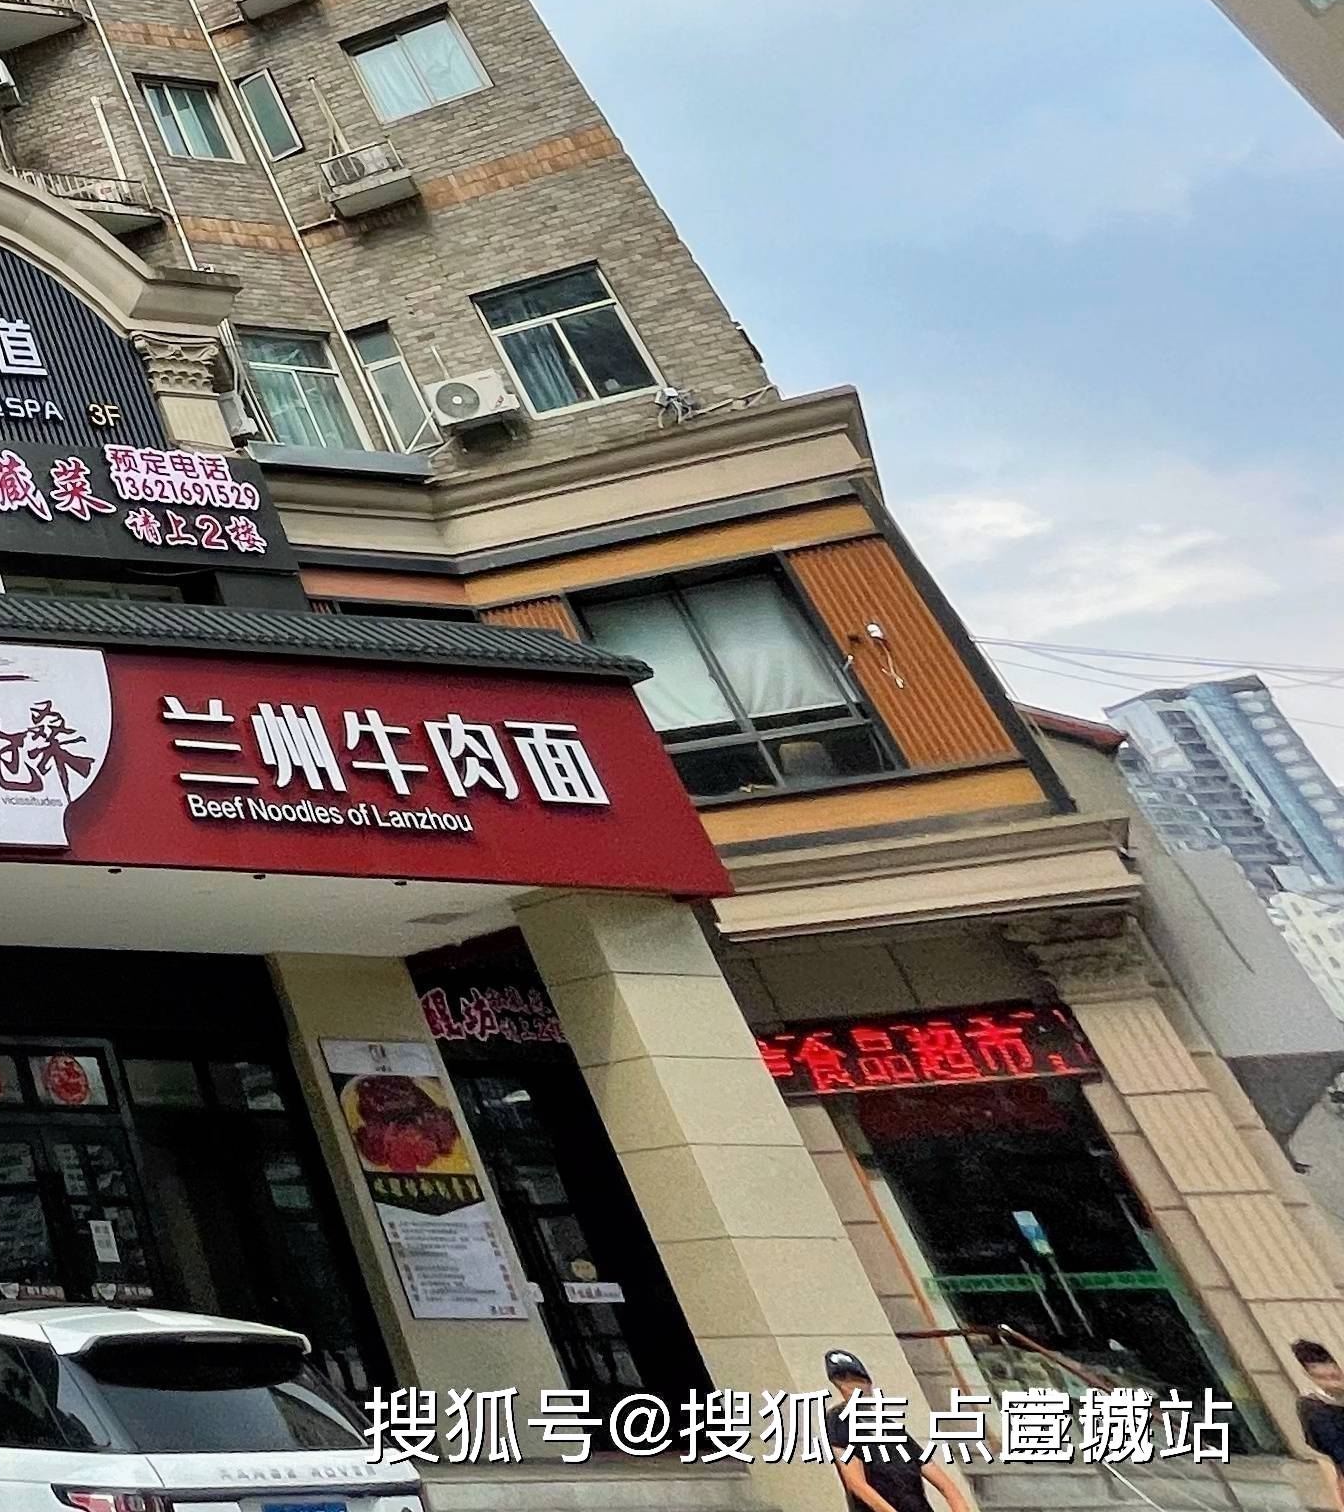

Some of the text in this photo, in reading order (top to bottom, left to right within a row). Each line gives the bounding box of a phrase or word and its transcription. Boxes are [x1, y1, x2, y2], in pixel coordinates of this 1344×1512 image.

[89, 403, 121, 427] 3F
[105, 444, 230, 482] 预定电话
[111, 473, 261, 511] 13621691529
[124, 508, 268, 554] 请上2楼
[161, 694, 612, 808] 兰州牛肉面
[186, 793, 474, 833] Beef Noodles of Lanzhou
